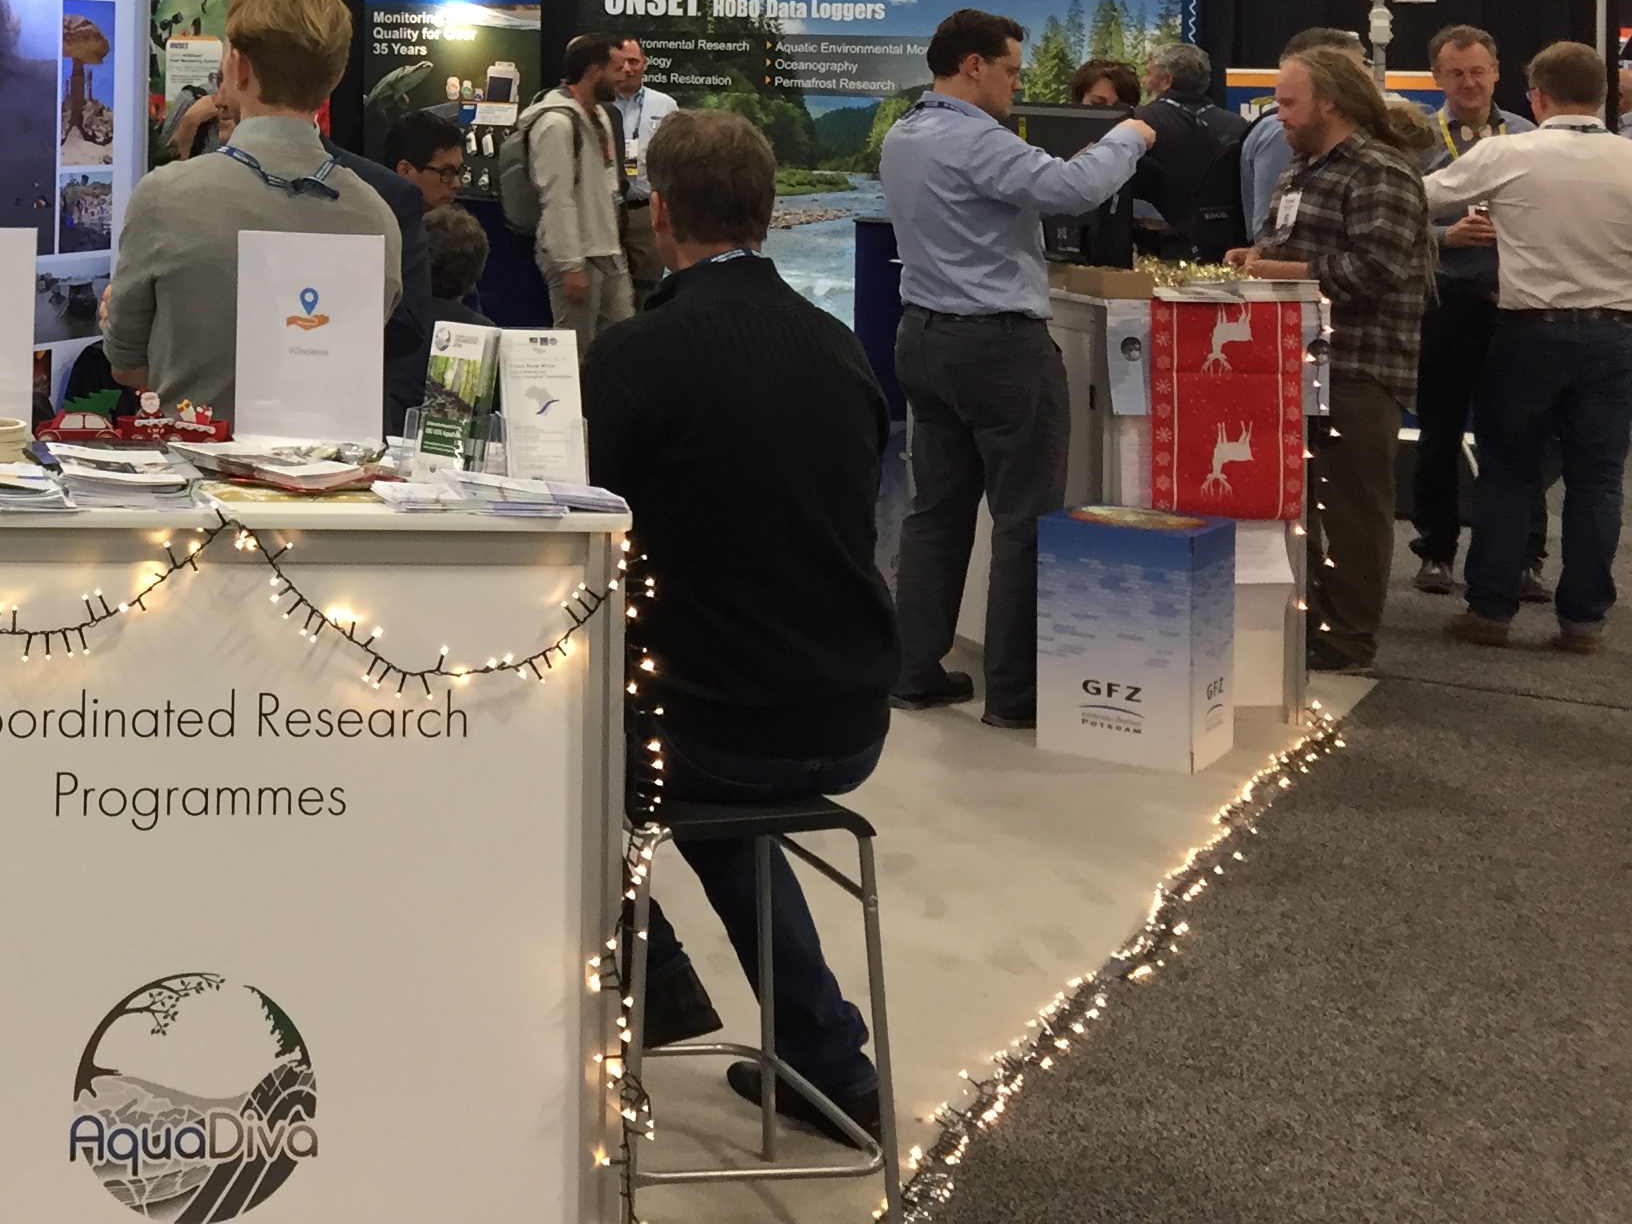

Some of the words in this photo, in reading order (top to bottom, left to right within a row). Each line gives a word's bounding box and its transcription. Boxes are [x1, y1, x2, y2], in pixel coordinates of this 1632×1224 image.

[373, 11, 440, 25] Monitorin
[811, 0, 886, 21] Loggers
[373, 28, 420, 41] Quality
[422, 28, 441, 40] for
[373, 44, 388, 56] 35
[391, 44, 428, 56] Years
[697, 39, 750, 52] Research
[775, 41, 818, 54] Aquatic
[820, 41, 904, 55] Environmental
[774, 58, 859, 74] Oceanography
[670, 73, 732, 86] Restoration
[774, 76, 838, 90] Permafrost
[839, 77, 896, 91] Research
[1081, 678, 1142, 704] GFZ
[1206, 676, 1225, 701] GFZ
[256, 688, 470, 740] Research
[1081, 717, 1142, 735] POTSDAM
[55, 770, 348, 832] Programmes
[68, 1109, 319, 1176] AquaDiva
